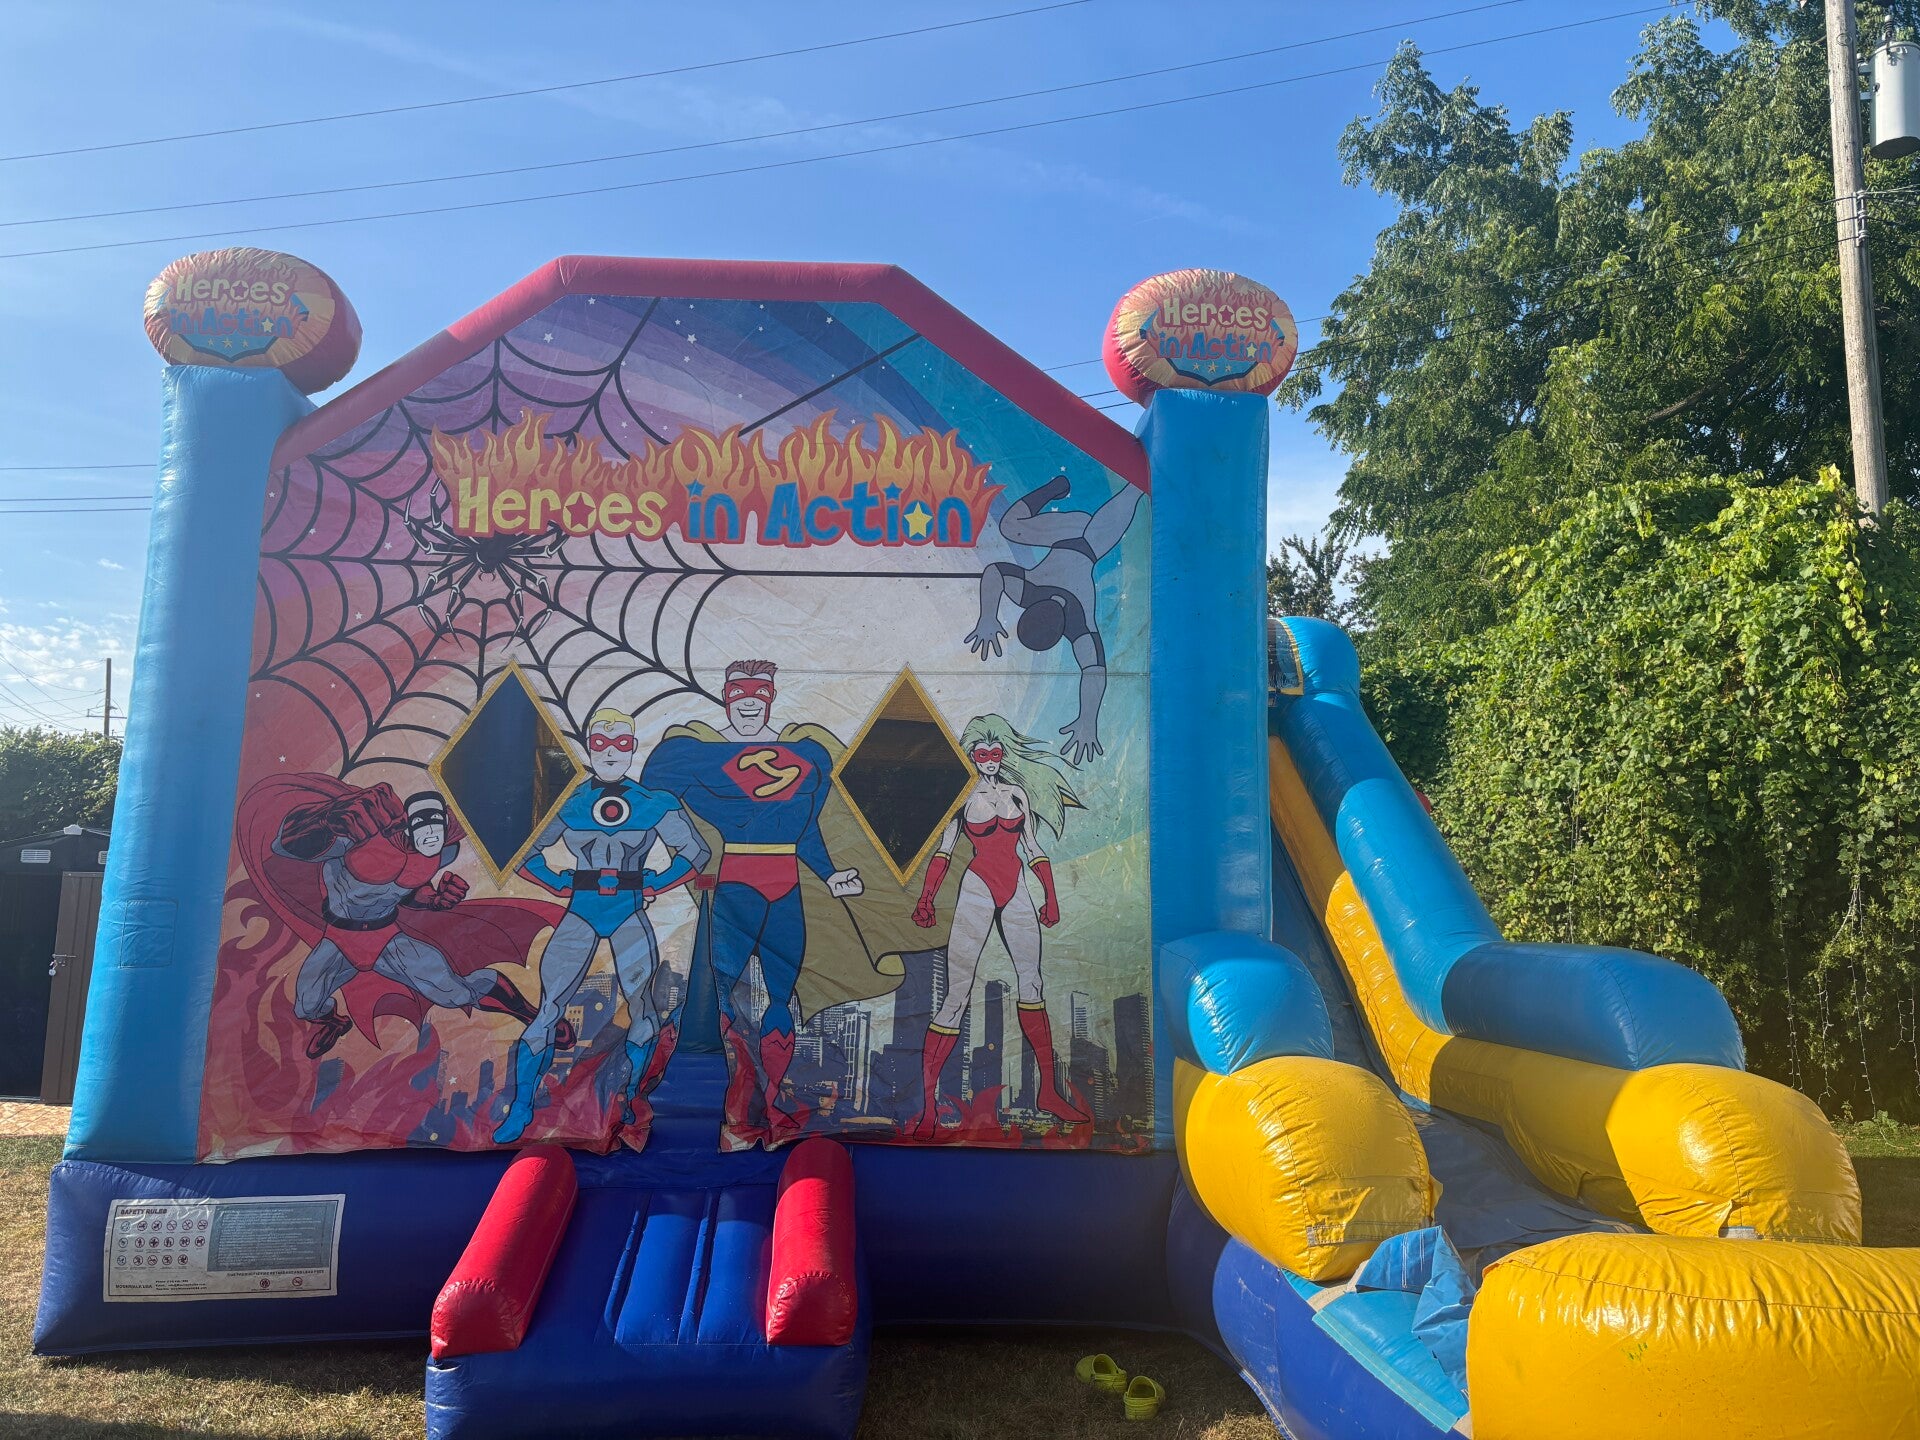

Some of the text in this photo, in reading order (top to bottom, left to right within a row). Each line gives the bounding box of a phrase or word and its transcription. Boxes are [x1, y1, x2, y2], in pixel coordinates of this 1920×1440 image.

[175, 274, 291, 304] Heroes
[169, 306, 293, 337] in Action
[1162, 297, 1270, 330] Heroes
[1158, 331, 1273, 362] in Action
[456, 475, 973, 544] Heroes in Action
